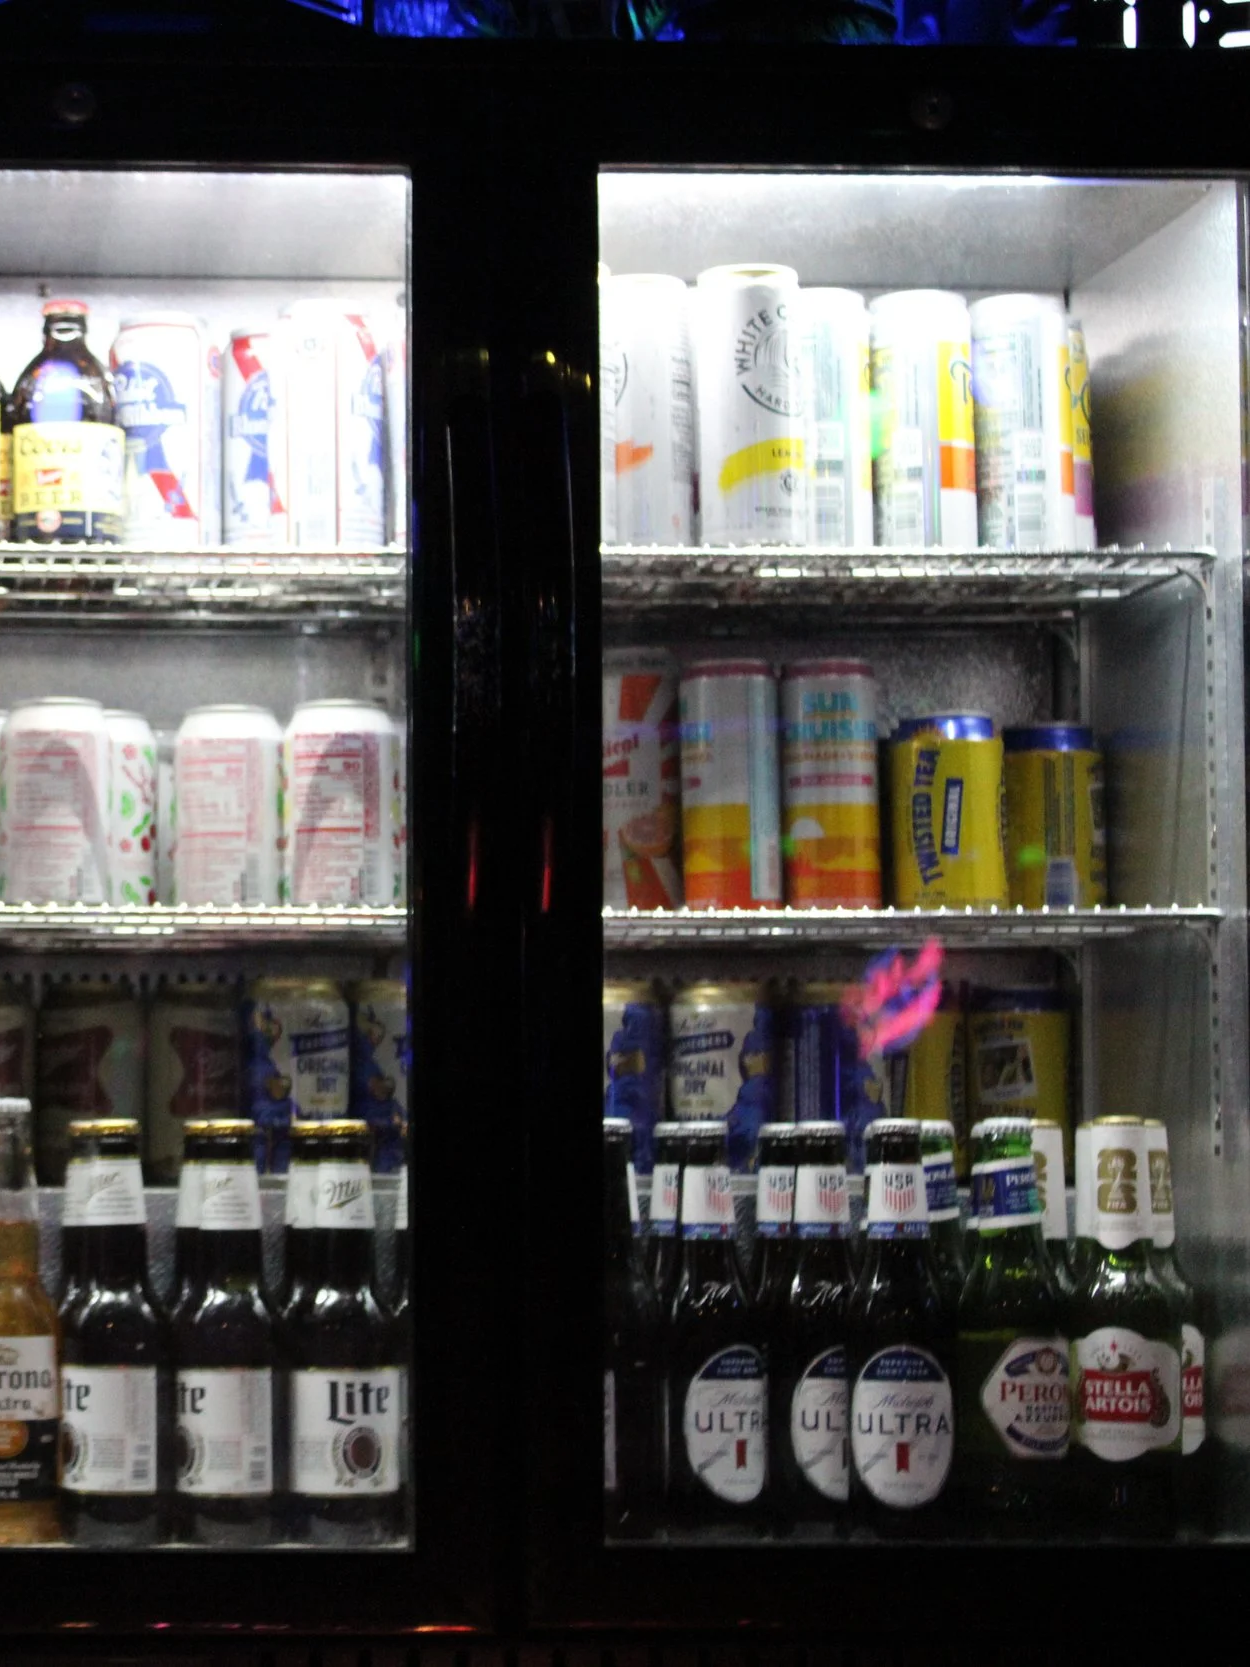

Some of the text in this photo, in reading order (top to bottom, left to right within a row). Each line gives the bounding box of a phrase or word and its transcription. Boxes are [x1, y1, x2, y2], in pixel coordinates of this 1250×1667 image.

[734, 308, 773, 377] WHITE
[884, 1172, 914, 1190] USA
[1000, 1381, 1068, 1402] PERO
[1085, 1379, 1150, 1396] STELLA
[326, 1380, 390, 1425] Lite
[1085, 1396, 1151, 1414] ARTOIS
[695, 1410, 761, 1433] ULTR
[857, 1411, 951, 1435] ULTRA
